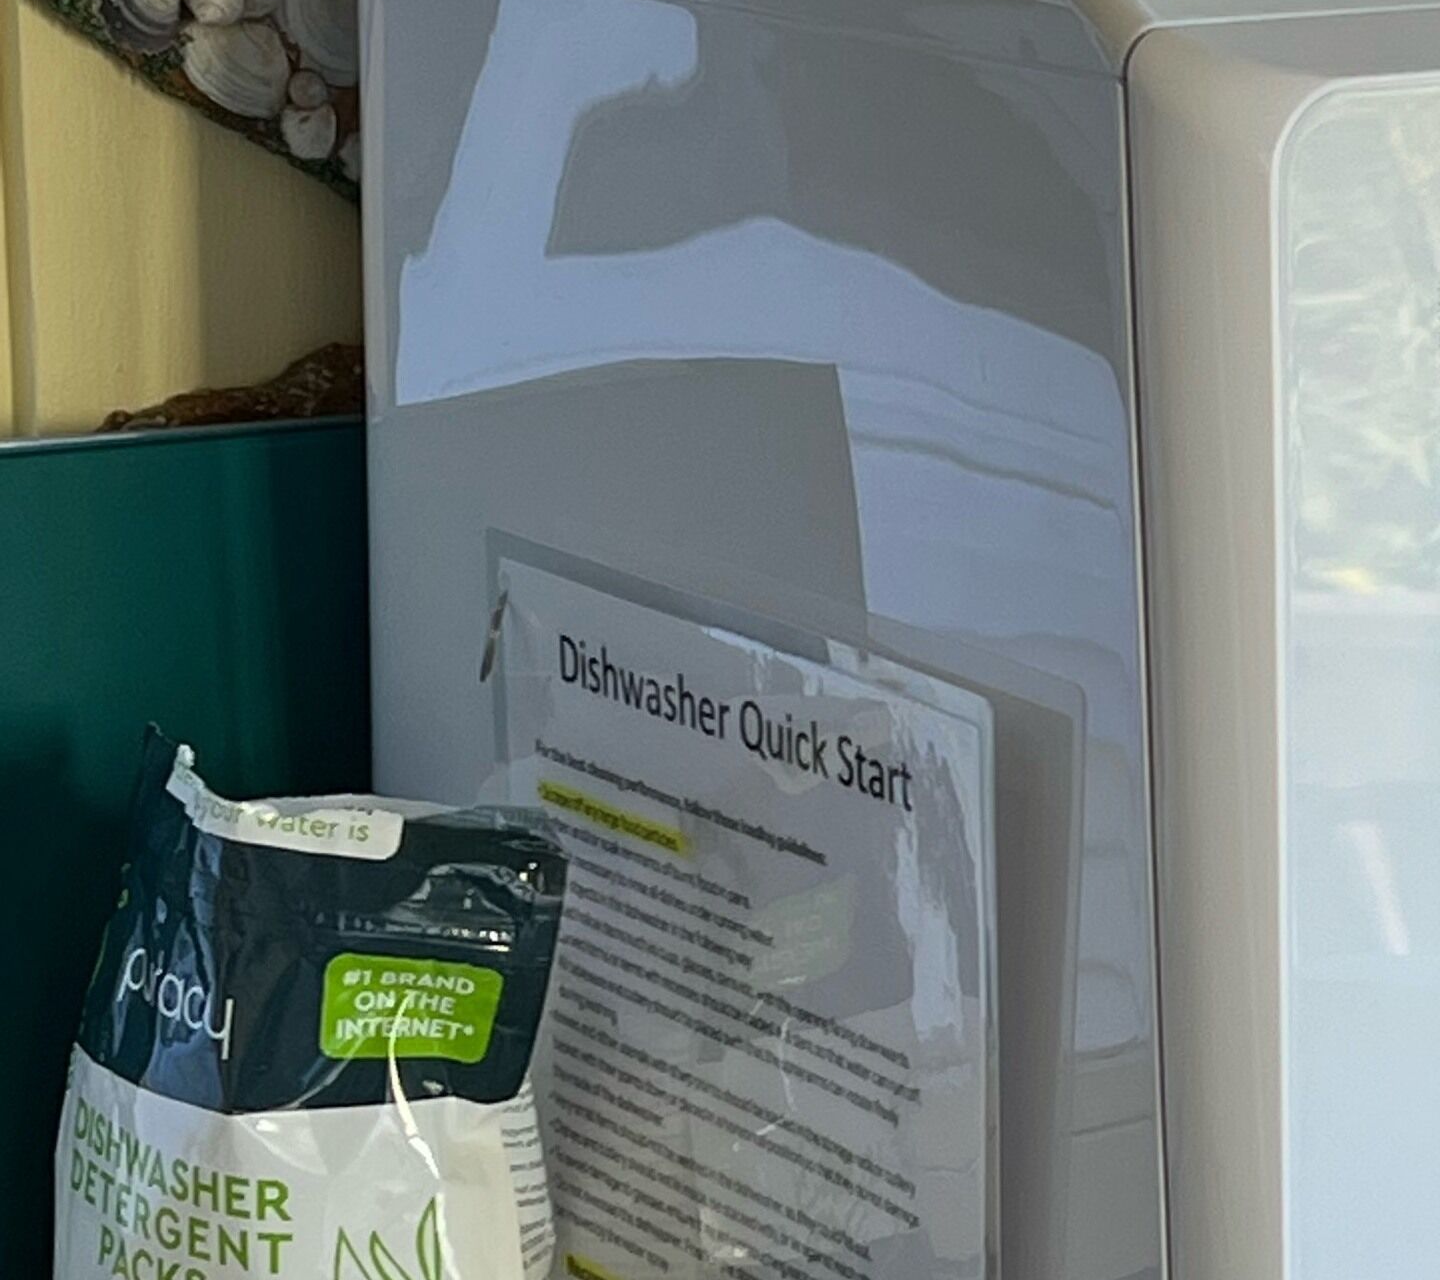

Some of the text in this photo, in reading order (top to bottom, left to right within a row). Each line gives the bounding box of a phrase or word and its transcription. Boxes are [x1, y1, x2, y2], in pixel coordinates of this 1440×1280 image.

[559, 634, 913, 812] Dishwasher Quick Start
[348, 820, 371, 842] is
[342, 970, 475, 995] #1 BRAND
[354, 989, 457, 1015] ON THE
[74, 1097, 292, 1221] DISHWASHER
[71, 1148, 293, 1274] DETERGENT
